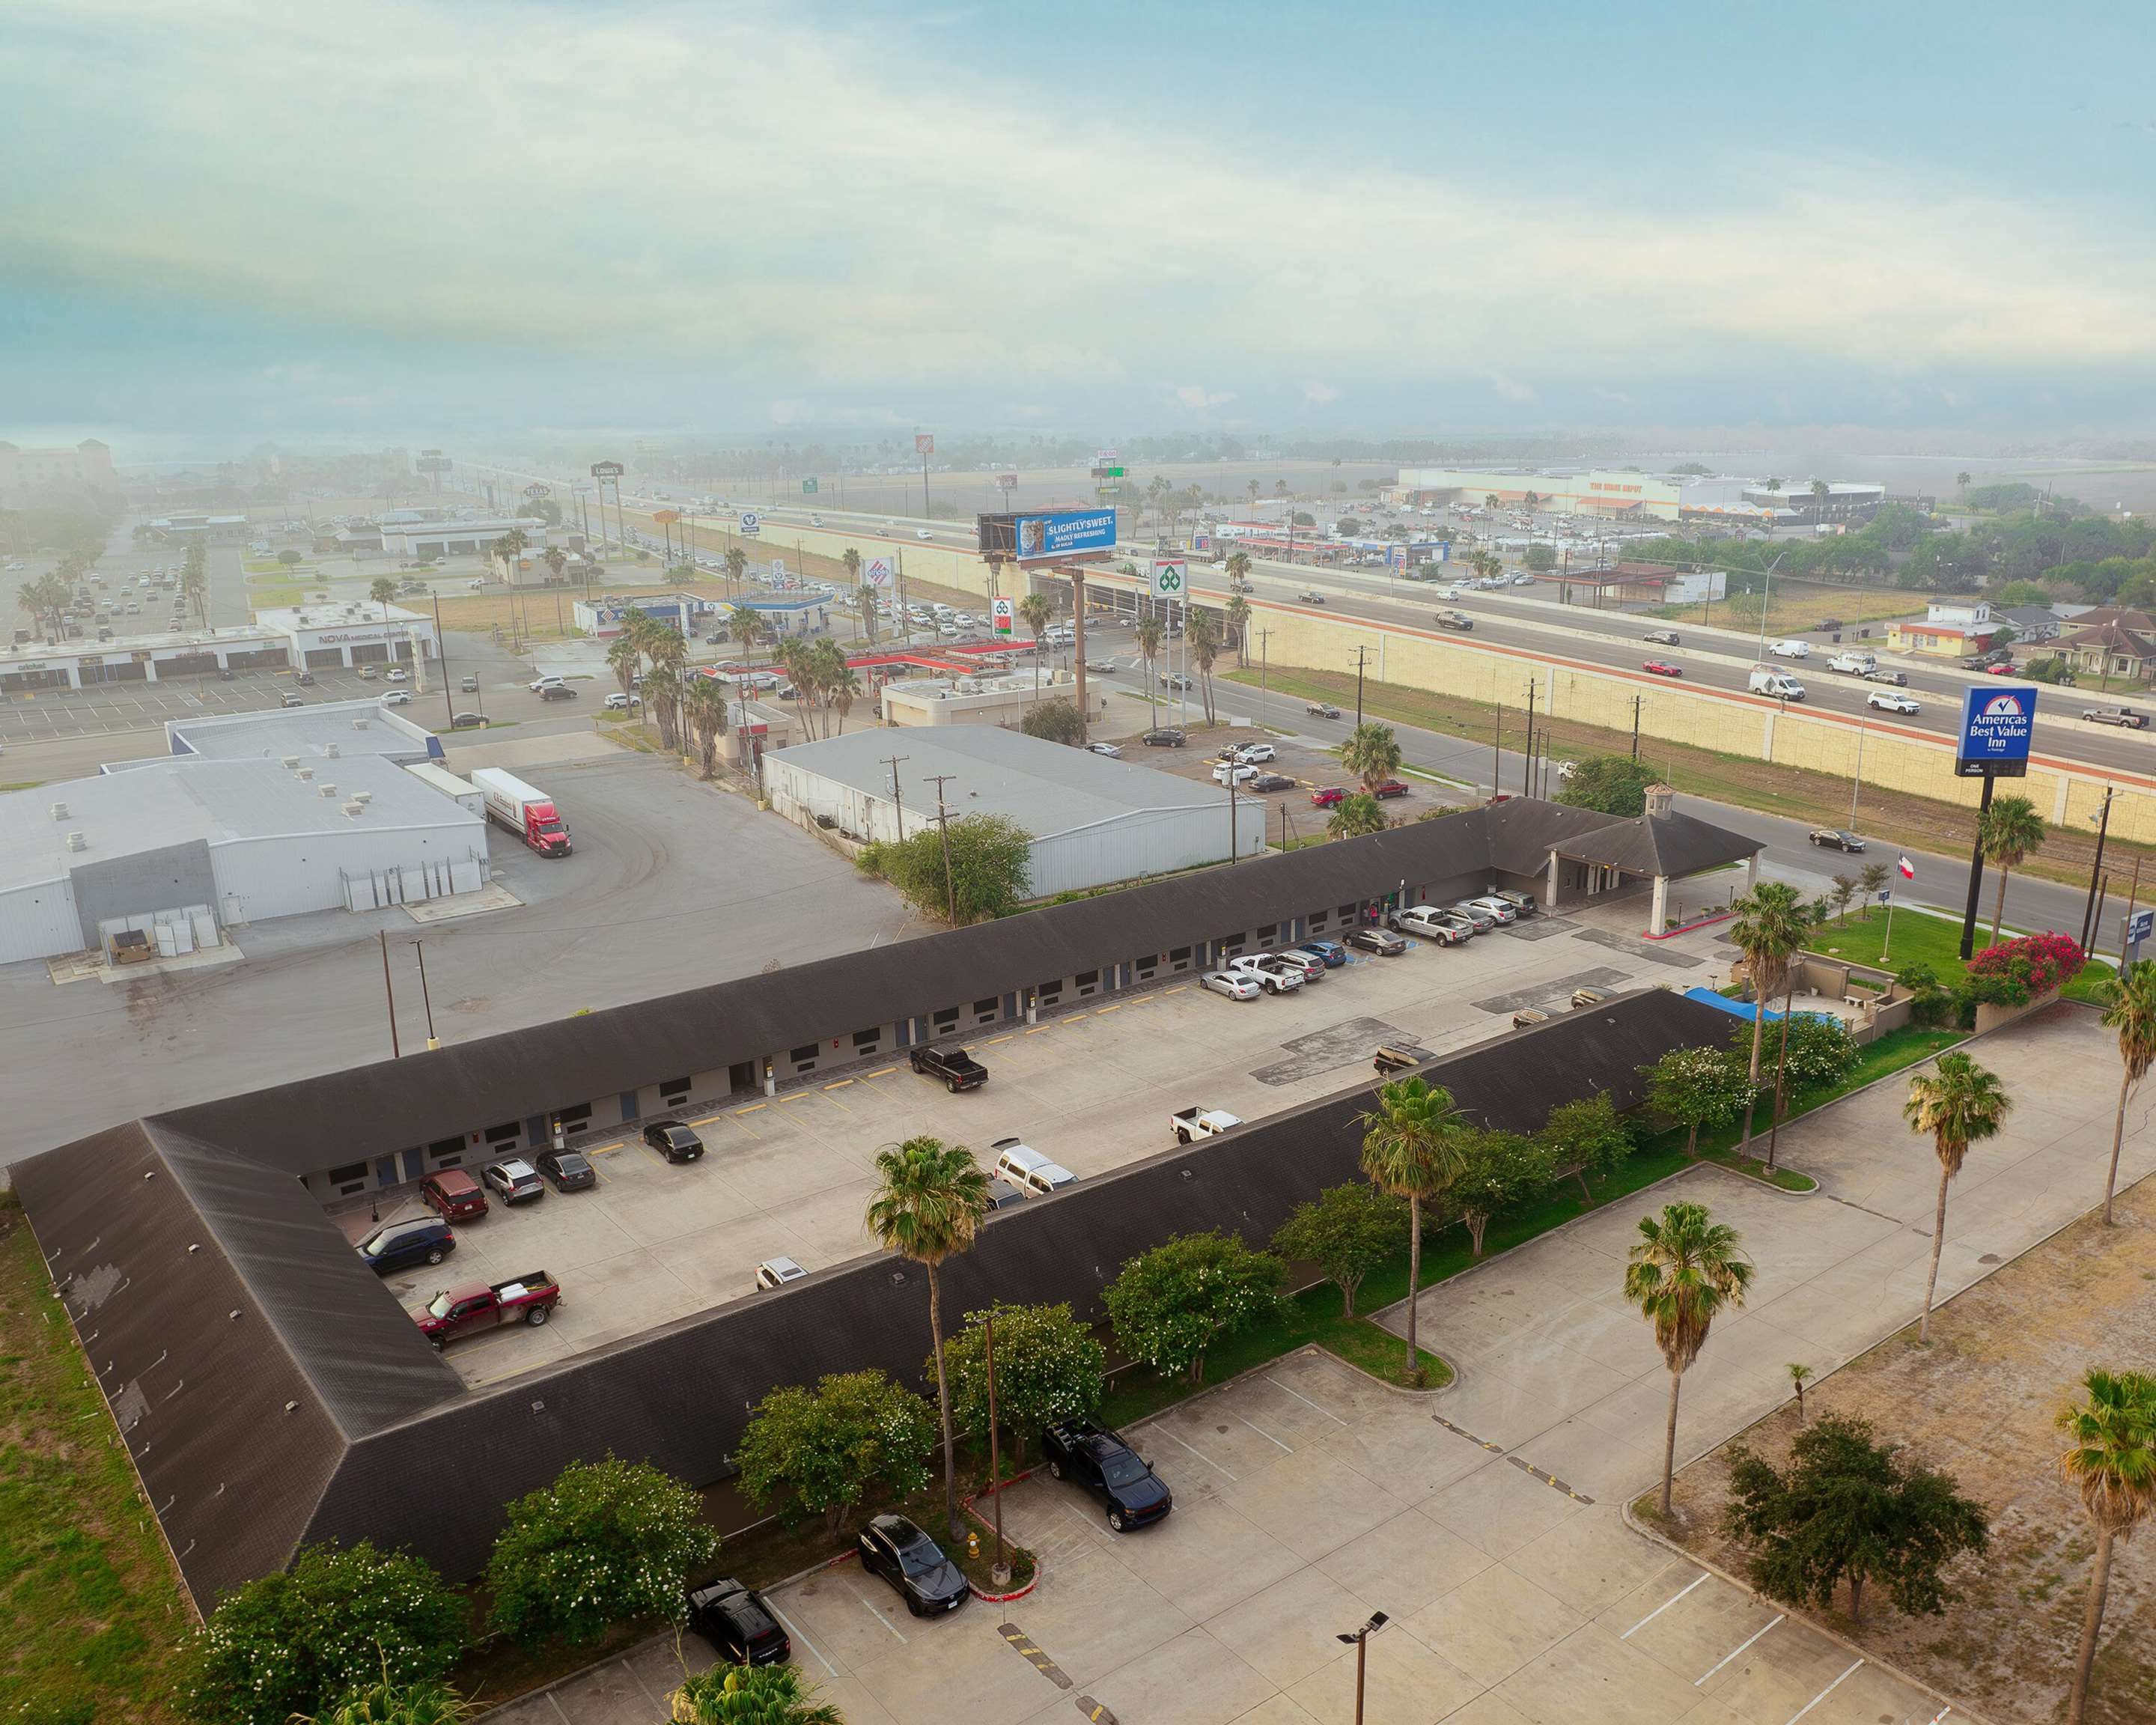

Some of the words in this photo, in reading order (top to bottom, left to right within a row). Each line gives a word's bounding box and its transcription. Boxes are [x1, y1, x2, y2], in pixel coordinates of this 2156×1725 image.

[1048, 519, 1085, 535] SLIGHTLY
[1074, 529, 1106, 539] REFRESHING
[318, 634, 351, 644] NOVA
[1973, 714, 2027, 725] Americas
[1970, 725, 1994, 736] Best
[1997, 725, 2027, 736] Value
[1988, 737, 2006, 747] Inn
